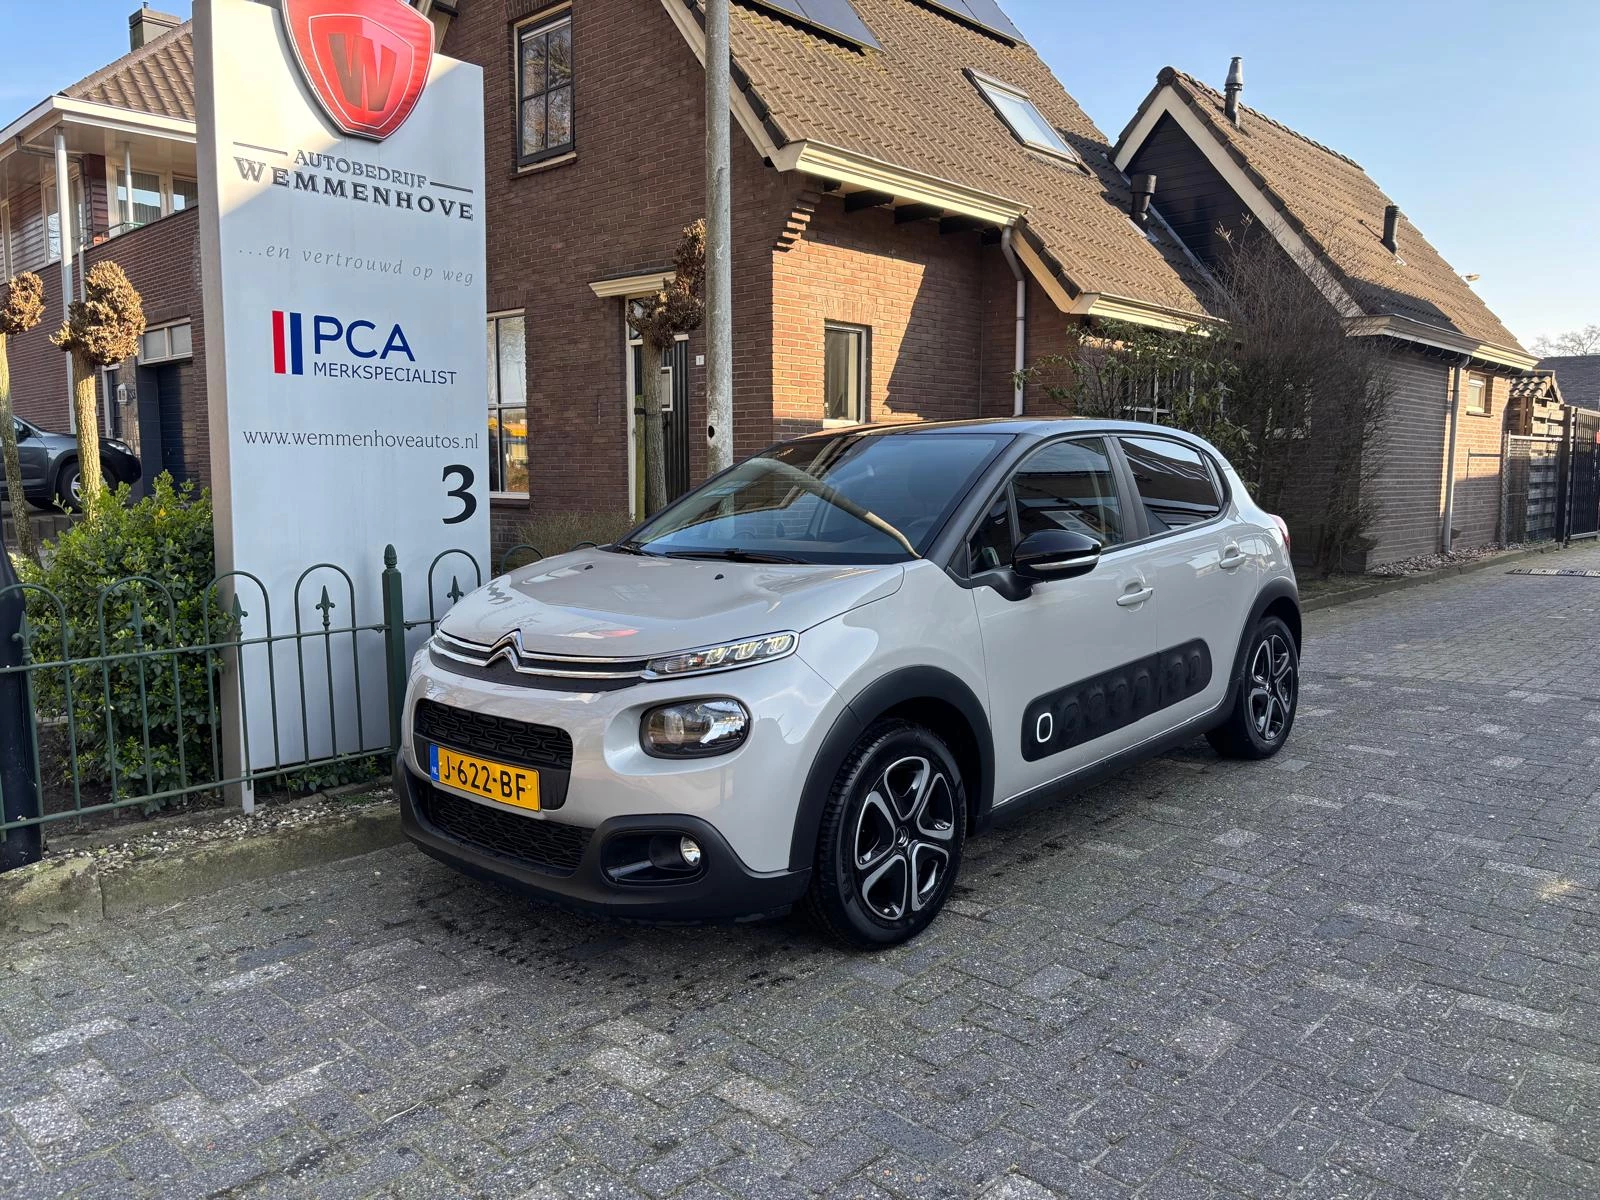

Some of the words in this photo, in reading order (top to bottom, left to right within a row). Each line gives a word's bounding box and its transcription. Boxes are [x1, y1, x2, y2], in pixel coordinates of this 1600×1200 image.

[328, 32, 398, 112] W
[233, 156, 474, 221] WEMMENHOVE
[294, 149, 428, 189] AUTOBEDRIJF
[302, 249, 403, 275] vertrouwd
[412, 264, 433, 280] op
[442, 268, 474, 287] weg
[313, 314, 416, 362] PCA
[313, 361, 457, 385] MERKSPECIALIST
[243, 429, 479, 449] www.wemmenhoveautos.nl
[441, 464, 478, 525] 3
[444, 755, 526, 801] J-622-BF
